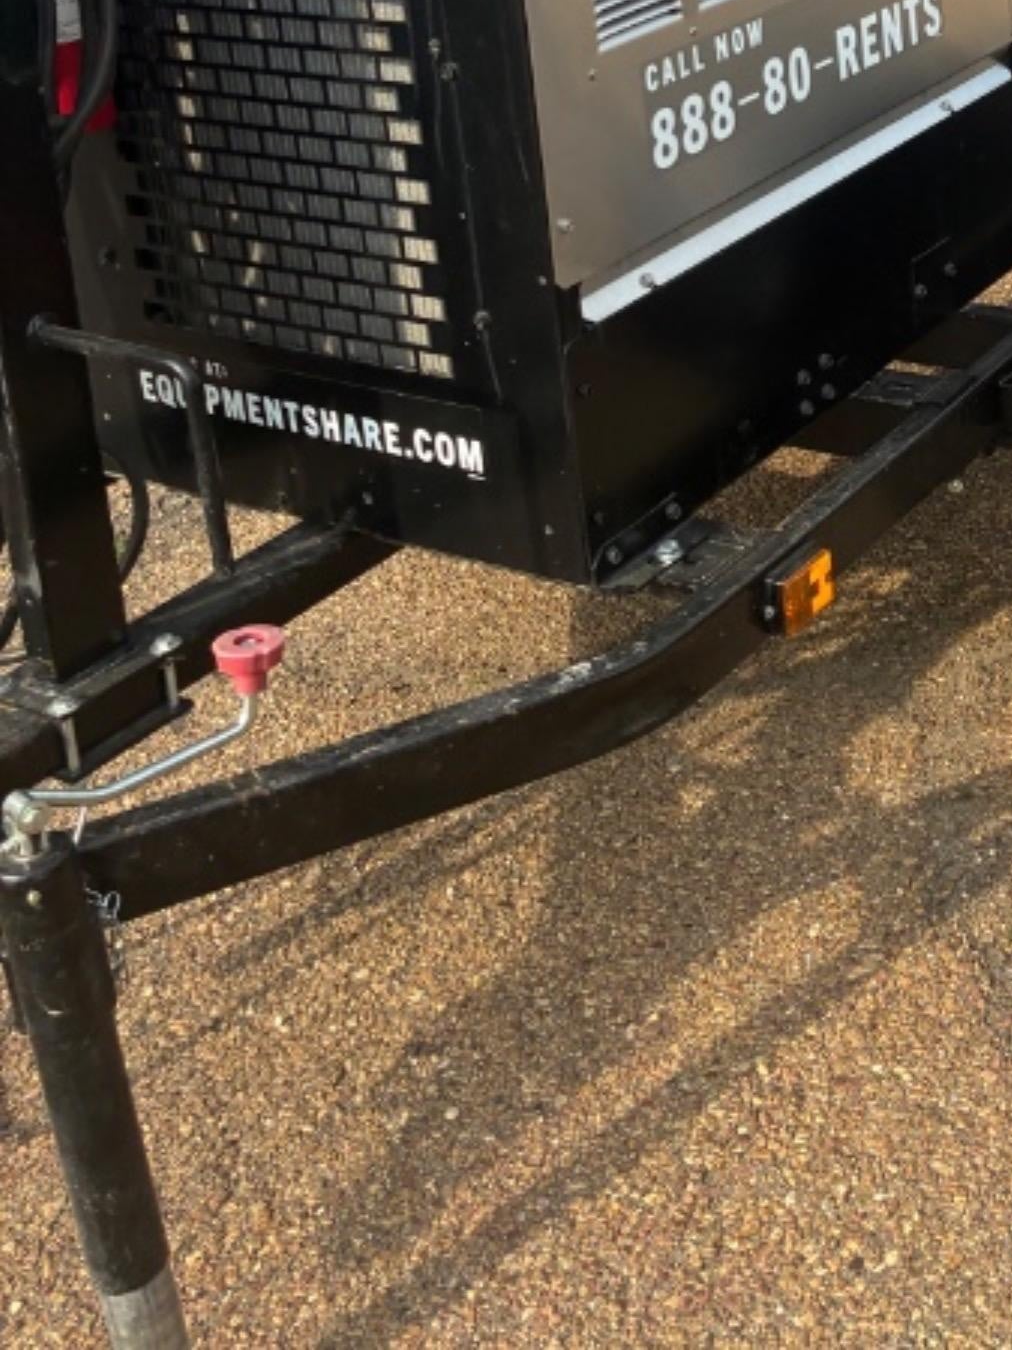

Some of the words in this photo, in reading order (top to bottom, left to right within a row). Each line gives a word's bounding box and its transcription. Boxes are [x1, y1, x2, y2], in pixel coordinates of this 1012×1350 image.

[644, 44, 706, 92] CALL
[714, 17, 764, 63] NOW
[139, 368, 485, 474] EQUPMENTSHARE.COM
